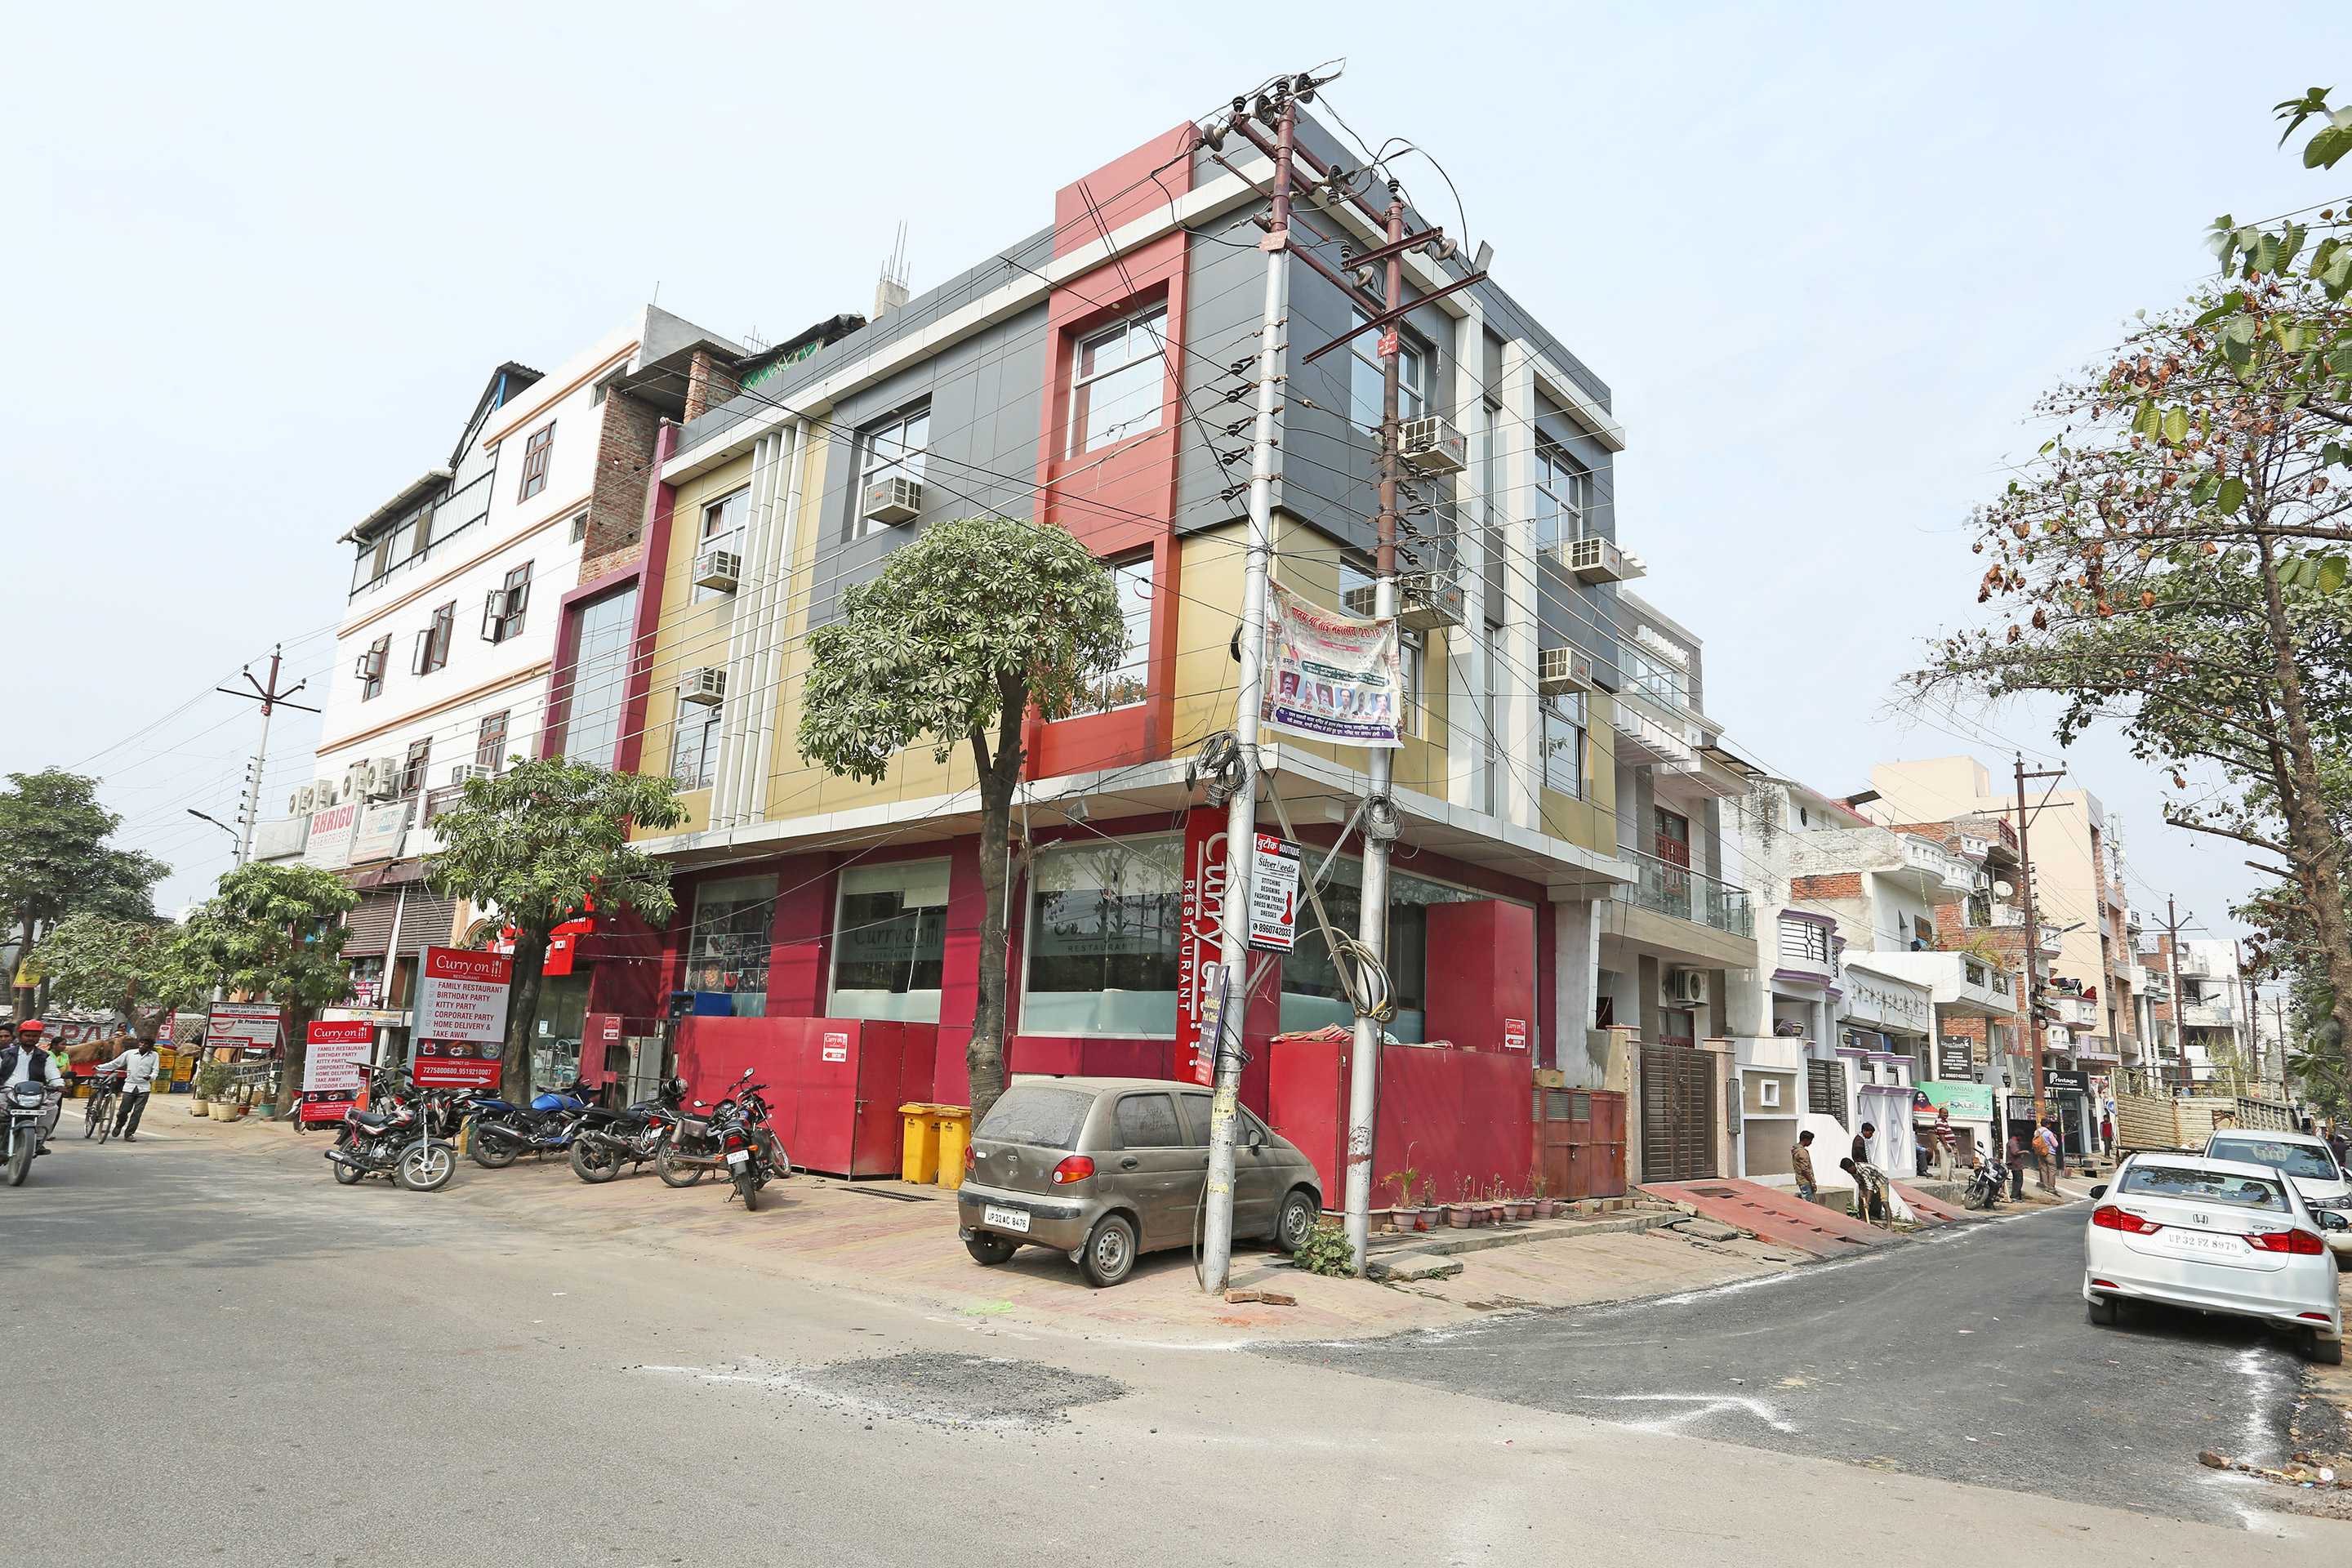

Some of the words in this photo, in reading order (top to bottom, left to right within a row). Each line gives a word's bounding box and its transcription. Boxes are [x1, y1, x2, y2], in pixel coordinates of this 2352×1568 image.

[1359, 626, 1383, 639] 2018
[312, 804, 354, 835] BHRIGU
[309, 829, 350, 849] ENTERPRISES
[1279, 843, 1300, 857] BOUTIQUE
[1258, 857, 1276, 869] Silver
[1262, 877, 1281, 887] STITCHING
[1261, 885, 1280, 894] DESIGNING
[1254, 892, 1270, 901] FASHION
[1271, 896, 1285, 904] TRENDS
[1254, 900, 1266, 908] DRESS
[1267, 903, 1284, 912] MATERIAL
[1260, 910, 1276, 918] DRESSES
[1178, 880, 1196, 1011] RESTAURANT
[436, 955, 473, 975] Curry
[474, 962, 490, 973] on
[438, 981, 461, 991] FAMILY
[462, 984, 503, 994] RESTAURANT
[437, 991, 469, 1000] BIRTHDAY
[470, 994, 490, 1002] PARTY
[456, 1003, 476, 1011] PARTY
[434, 1011, 473, 1020] CORPORATE
[474, 1013, 494, 1022] PARTY
[454, 1022, 484, 1031] DELIVERY
[314, 1027, 342, 1040] Curry
[345, 1029, 357, 1037] on
[2049, 1071, 2078, 1085] Printage
[2252, 1223, 2278, 1232] CITY
[2168, 1233, 2181, 1244] UP
[2182, 1233, 2195, 1246] 32
[2212, 1239, 2238, 1251] 8979
